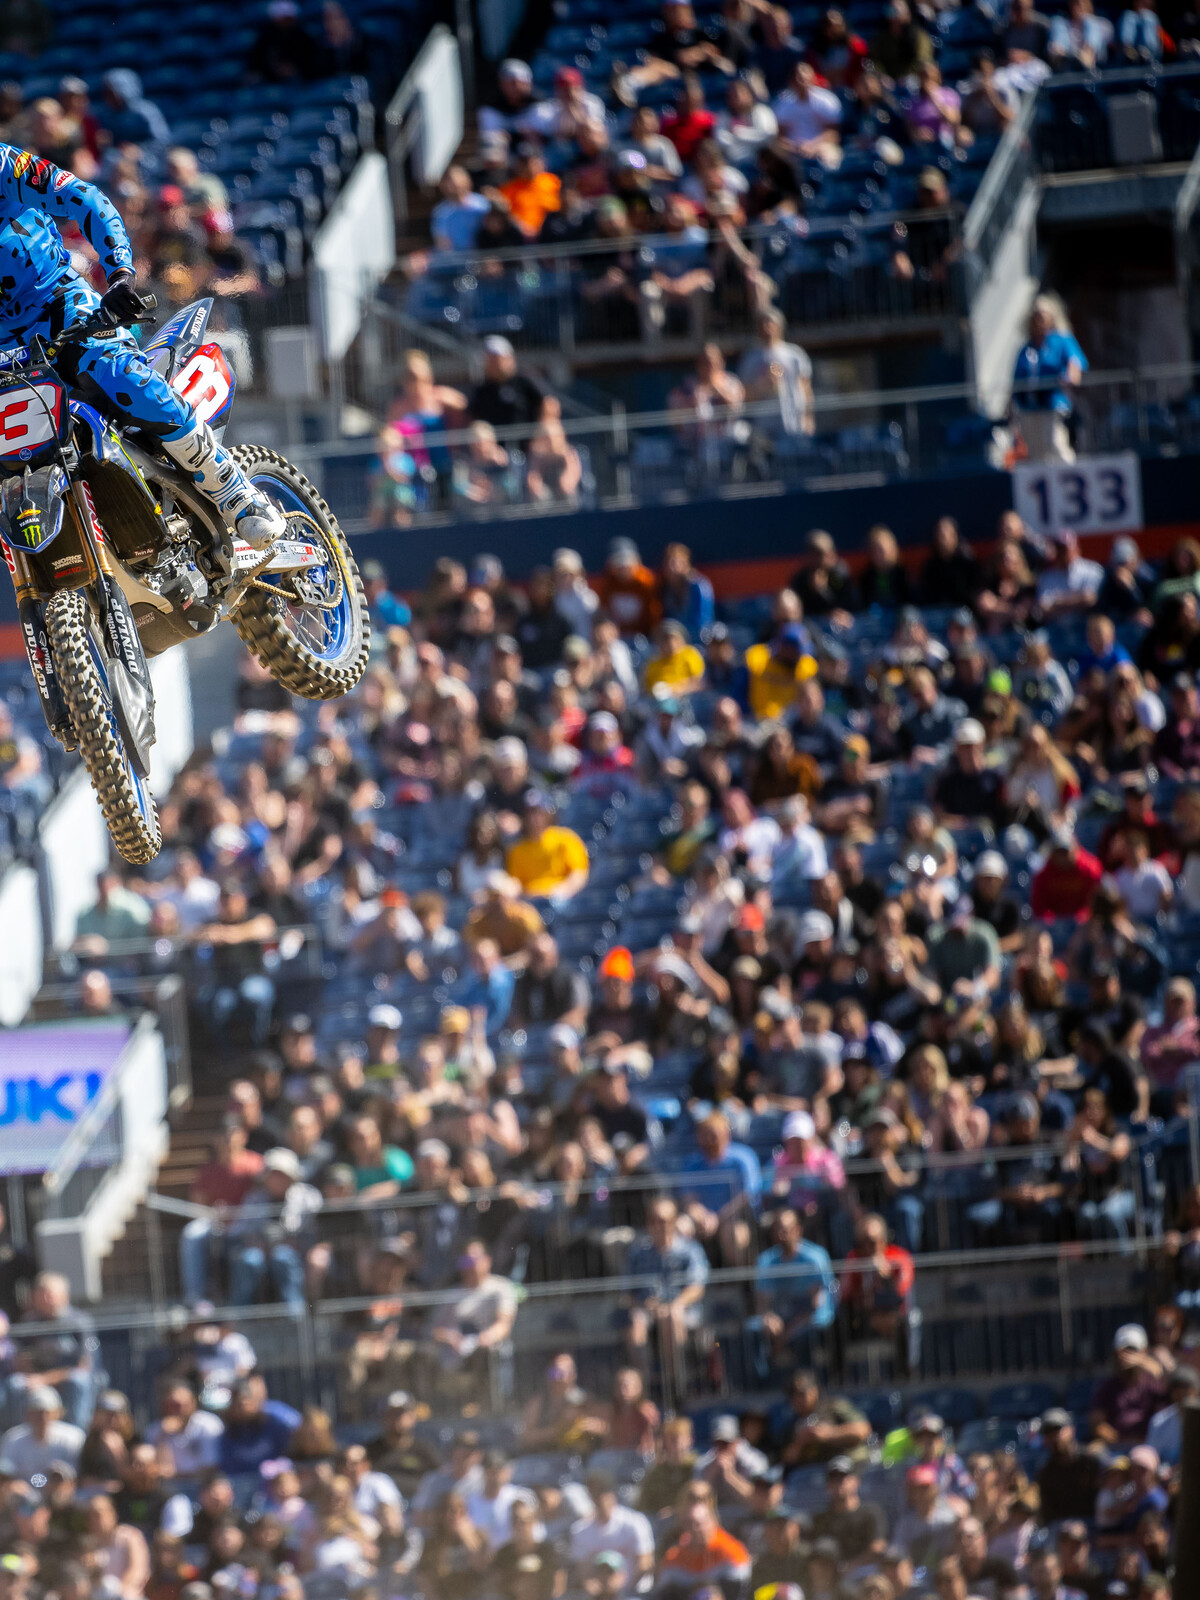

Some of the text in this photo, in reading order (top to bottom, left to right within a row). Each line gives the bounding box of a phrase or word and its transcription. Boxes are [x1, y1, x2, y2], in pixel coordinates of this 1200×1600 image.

[190, 306, 208, 339] DUNLOP
[172, 354, 231, 422] 3
[1027, 467, 1129, 526] 133
[23, 622, 50, 700] DUNLOP
[110, 598, 140, 675] DUNLOP
